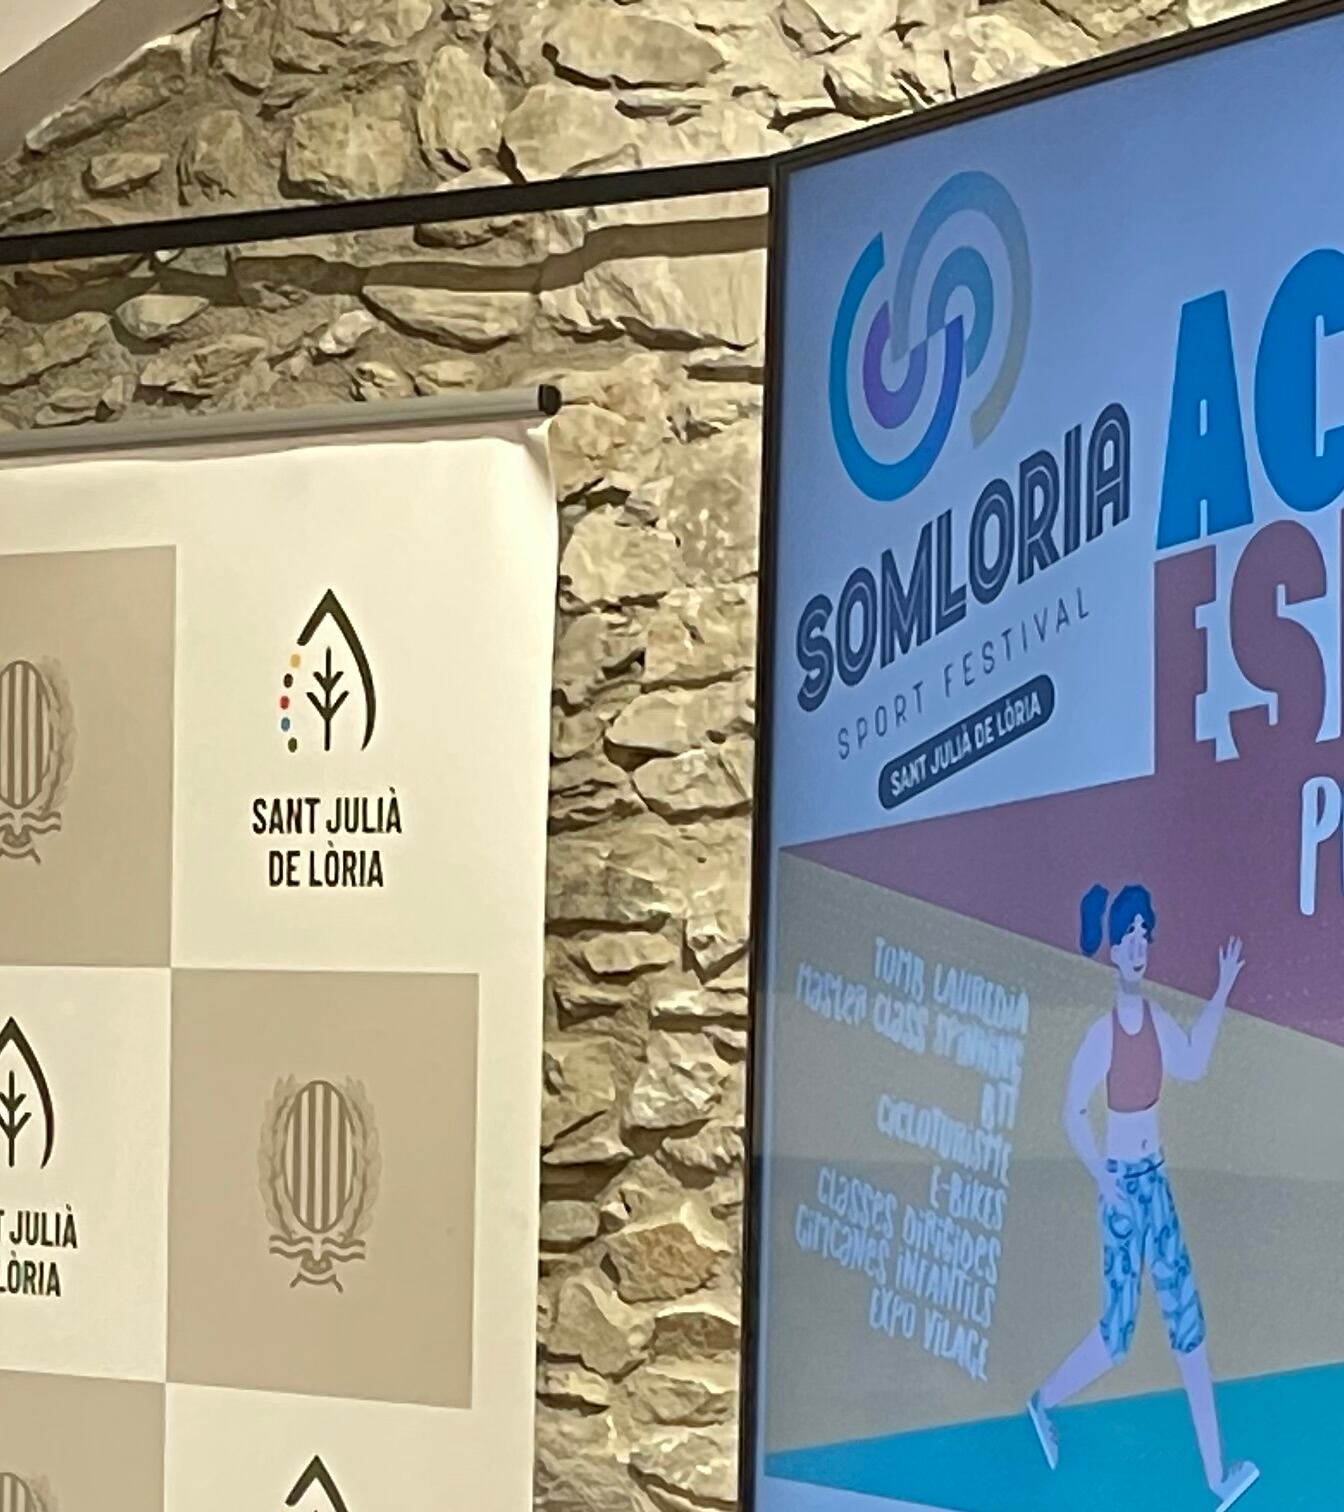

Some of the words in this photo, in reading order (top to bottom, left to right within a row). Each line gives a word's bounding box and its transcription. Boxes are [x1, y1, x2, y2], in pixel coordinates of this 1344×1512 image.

[797, 402, 1131, 713] SOMLORIA
[837, 680, 924, 761] SPORT
[942, 586, 1092, 699] FESTIVAL
[889, 753, 927, 798] SANT
[929, 724, 973, 776] JULIÀ
[974, 712, 995, 750] DE
[995, 690, 1043, 738] LÒRIA
[252, 796, 323, 835] SANT
[325, 786, 403, 837] JULIÀ
[268, 849, 301, 889] DE
[308, 840, 385, 889] LÒRIA
[9, 1203, 78, 1250] JULIÀ
